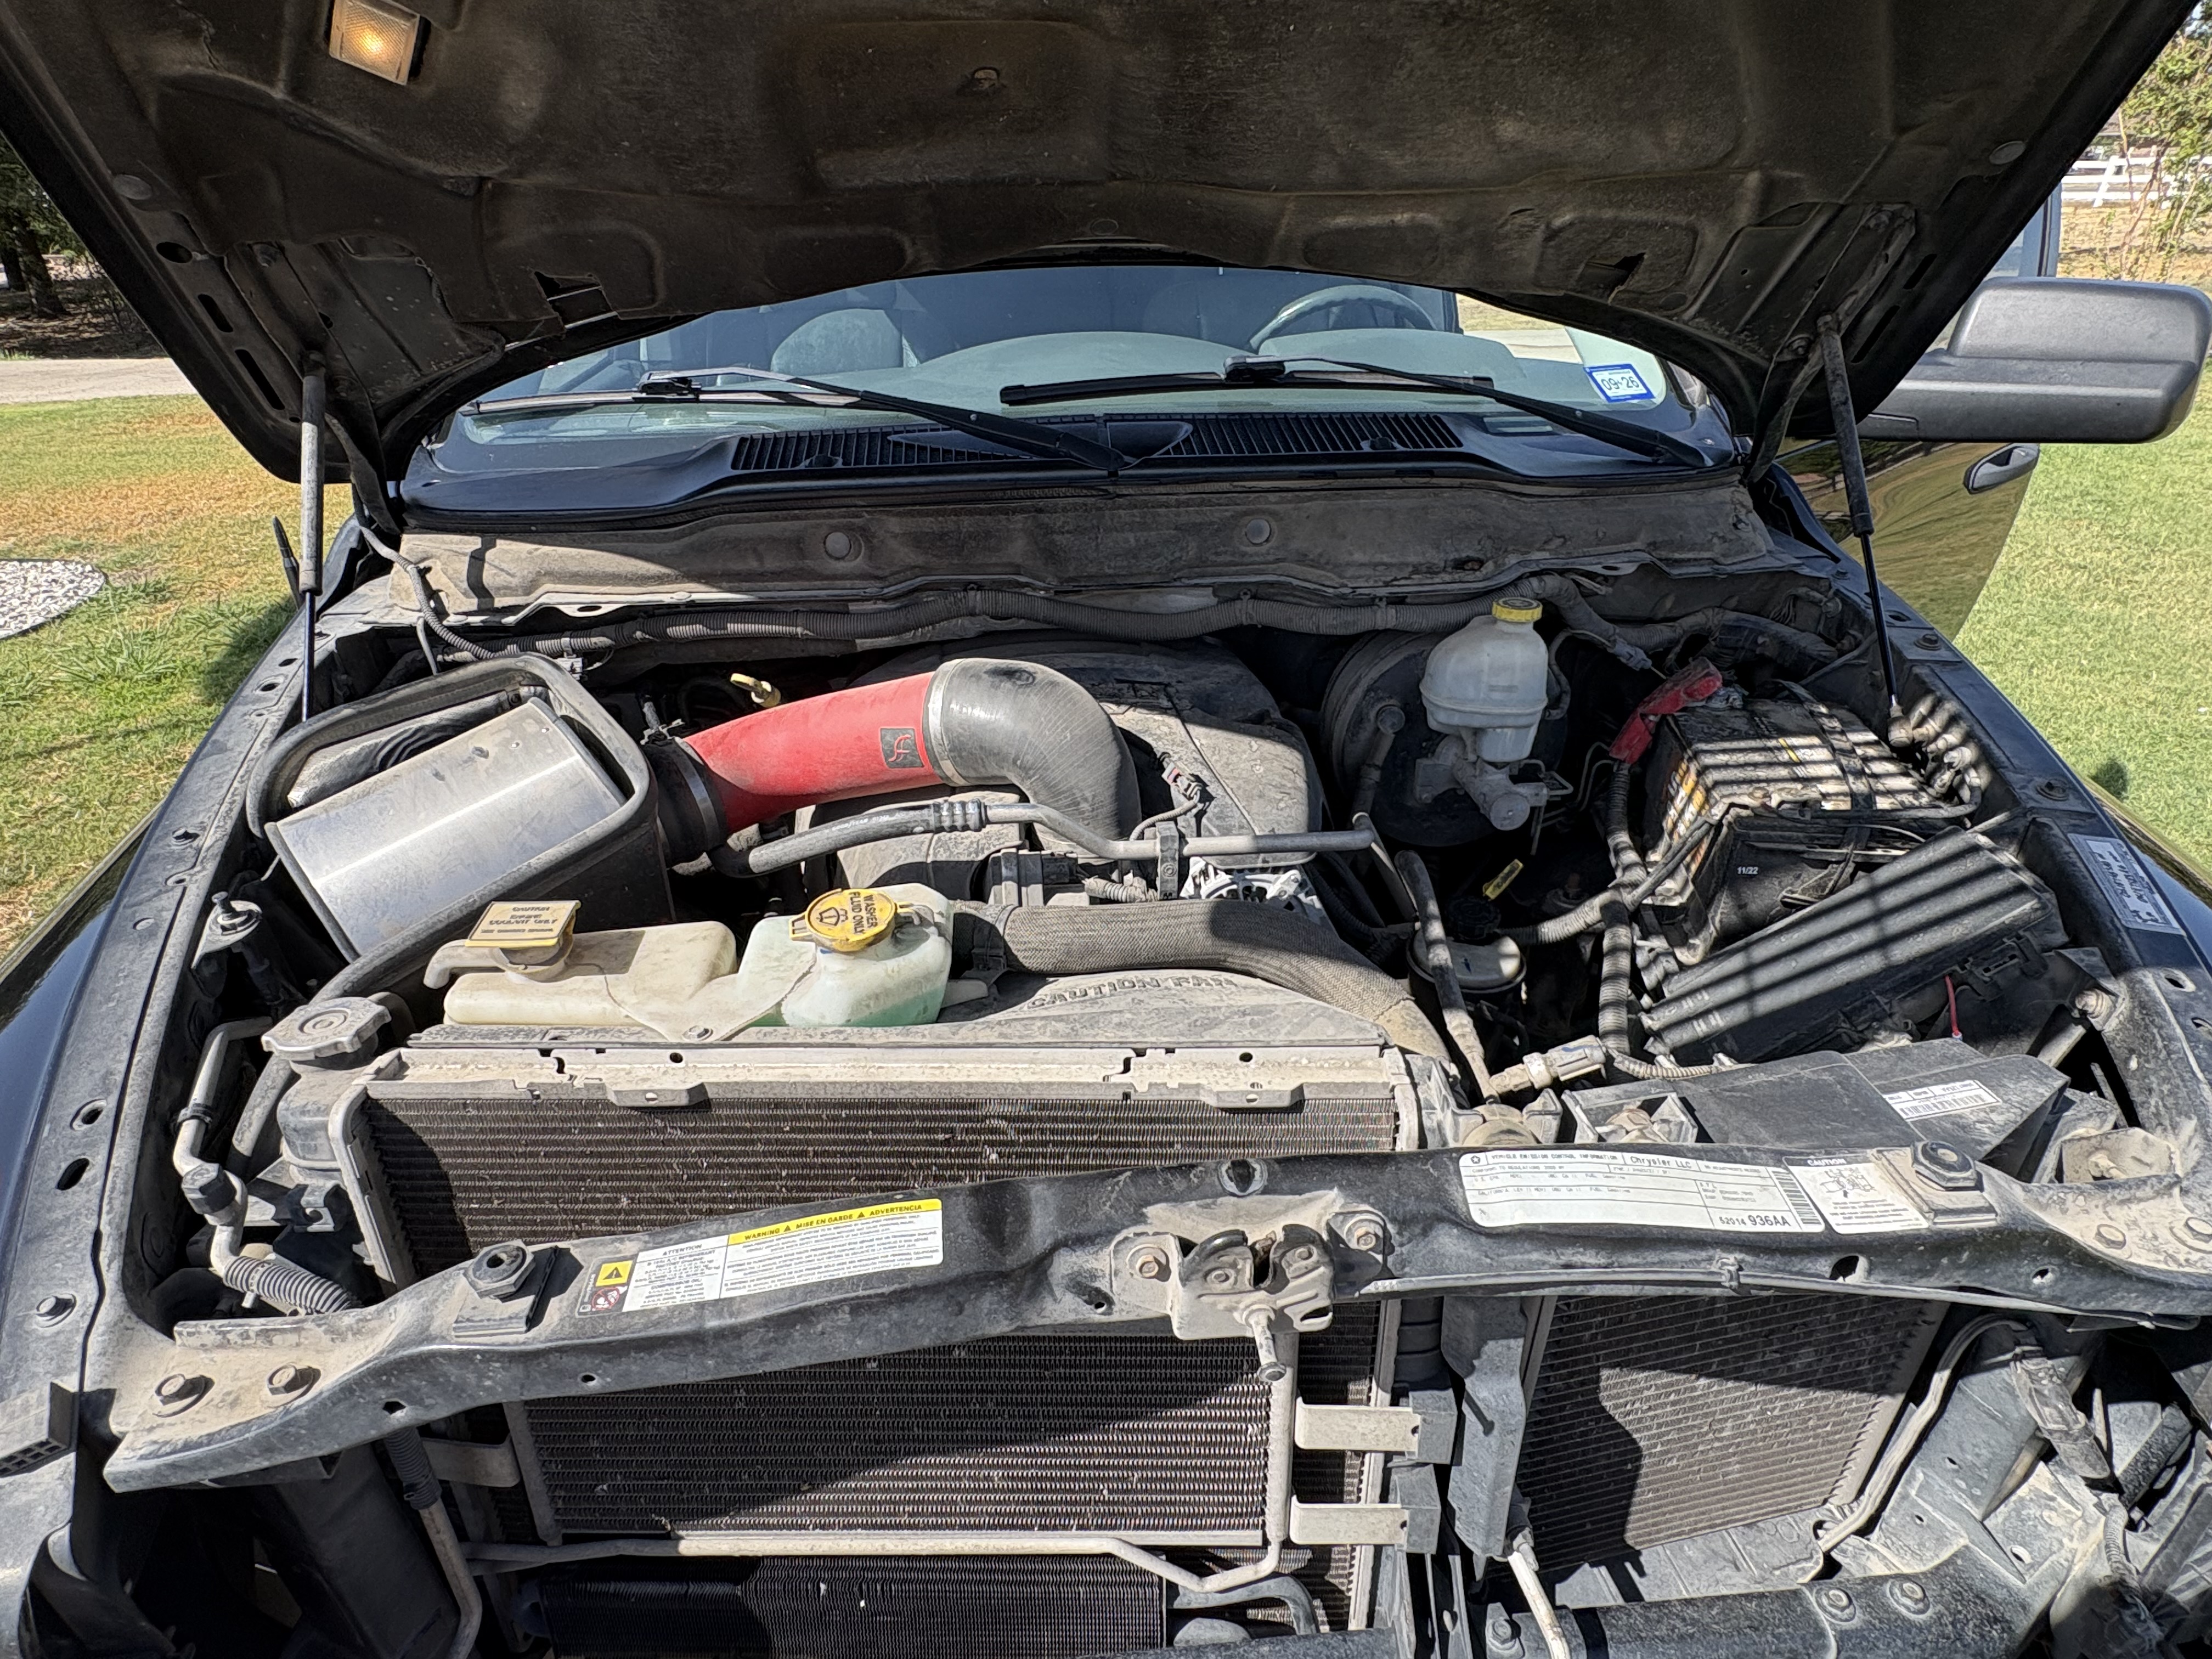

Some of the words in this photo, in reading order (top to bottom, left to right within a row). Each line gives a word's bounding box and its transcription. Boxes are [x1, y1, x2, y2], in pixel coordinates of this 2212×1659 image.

[1737, 866, 1759, 874] 11/22
[849, 891, 862, 913] FLUID
[863, 894, 878, 928] WASHER
[853, 915, 865, 935] ONLY
[1027, 974, 1163, 1009] CAUTION
[1170, 974, 1239, 989] FAN
[1630, 1155, 1671, 1167] Chrysler
[1675, 1160, 1691, 1169] LLC
[744, 1228, 780, 1240] WARNING
[796, 1220, 814, 1229] MISE
[827, 1214, 854, 1224] GARDE
[869, 1204, 923, 1217] ADVERTENCIA
[1719, 1216, 1747, 1226] 52014
[1748, 1214, 1792, 1227] 936AA
